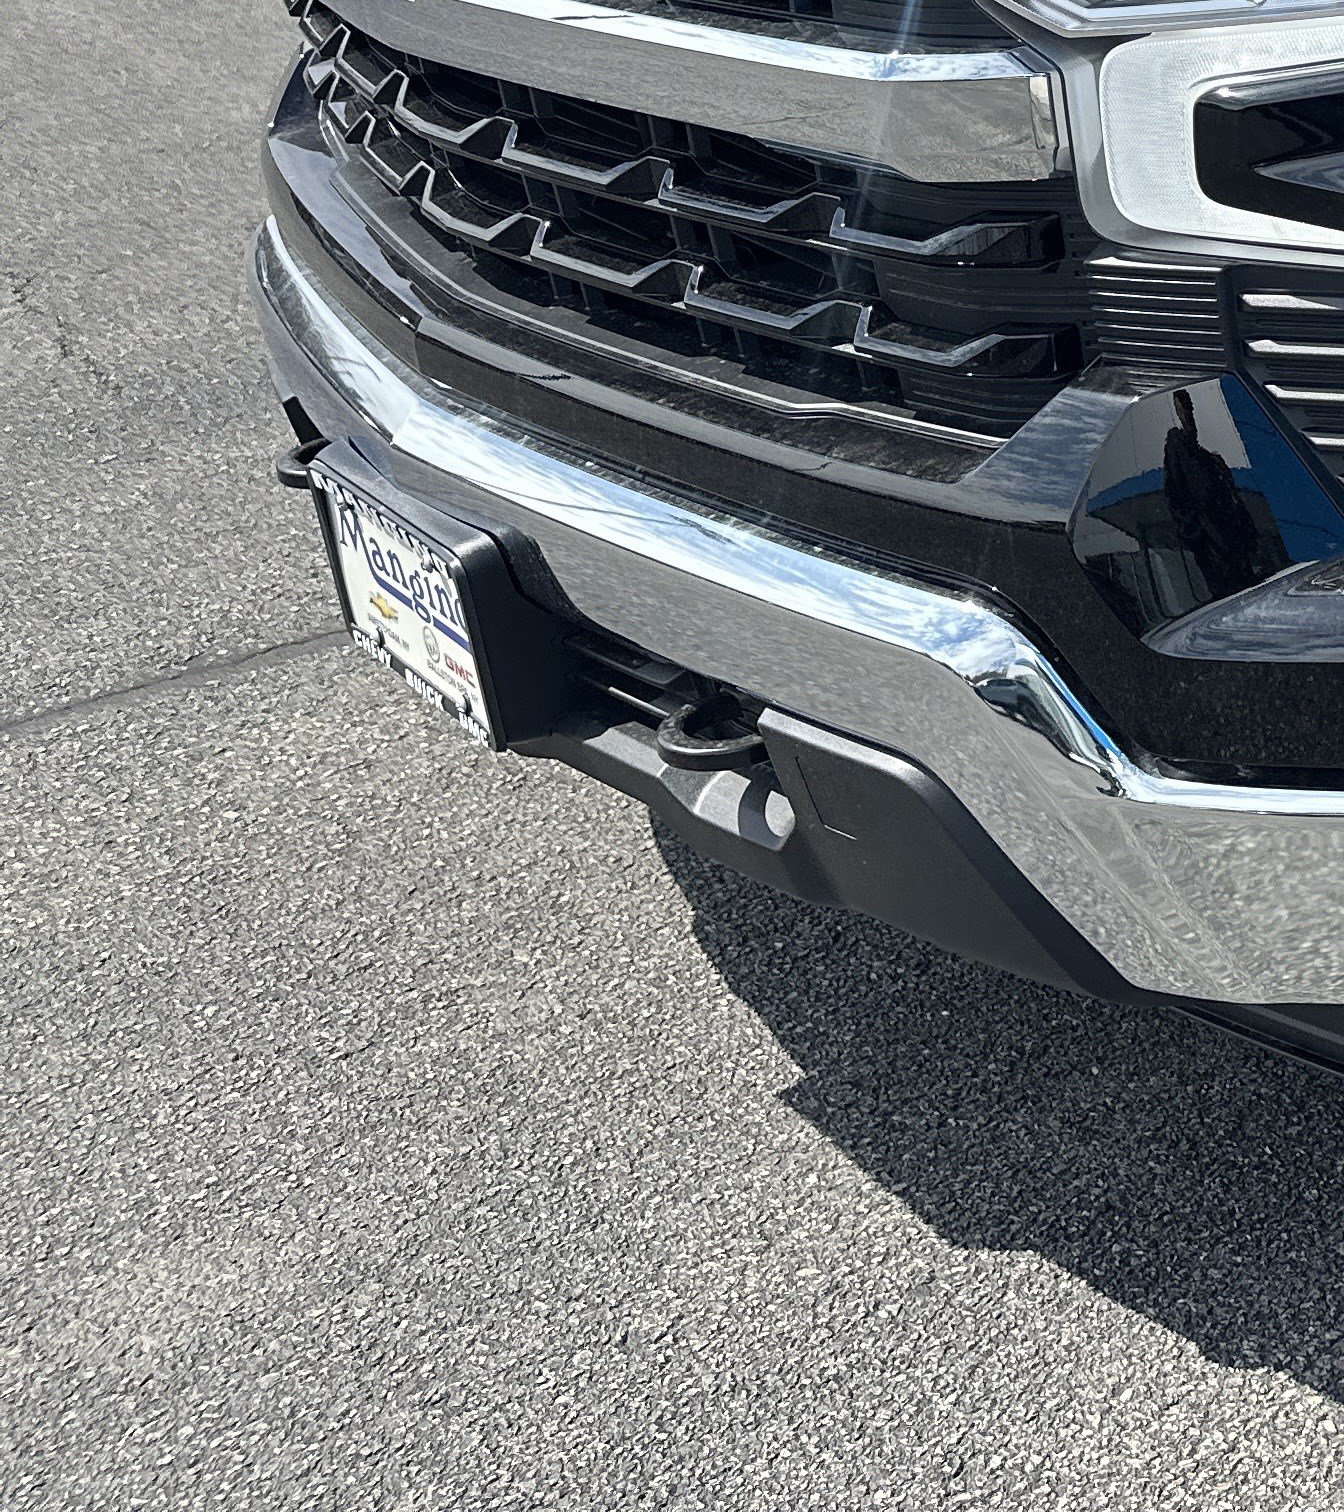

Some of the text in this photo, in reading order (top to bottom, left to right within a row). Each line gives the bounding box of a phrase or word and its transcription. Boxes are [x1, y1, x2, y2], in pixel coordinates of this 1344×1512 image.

[352, 629, 392, 669] CHEVY
[404, 668, 444, 711] BUICK
[444, 653, 476, 689] GMC
[458, 710, 489, 748] GMC
